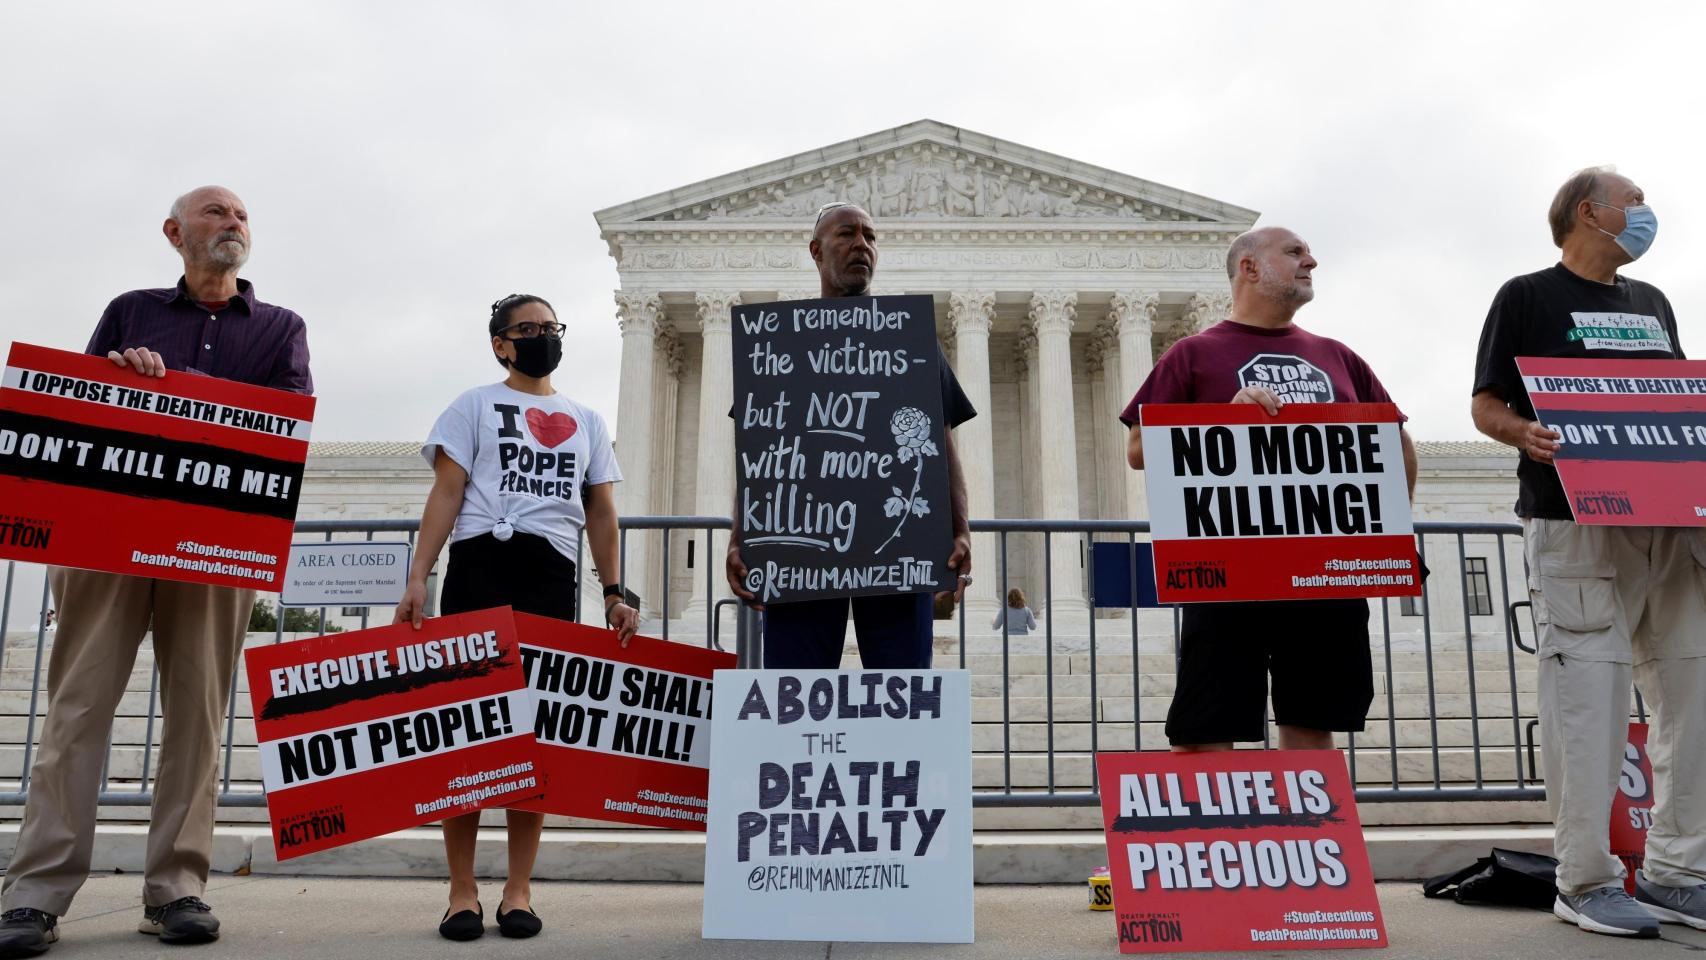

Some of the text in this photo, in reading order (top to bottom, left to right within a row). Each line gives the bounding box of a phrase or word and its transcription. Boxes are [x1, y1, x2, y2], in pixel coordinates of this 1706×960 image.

[877, 253, 939, 265] USTICE
[793, 298, 911, 332] remember
[1570, 328, 1622, 341] JOURNEY
[1627, 329, 1641, 339] OF
[749, 341, 794, 376] the
[1252, 363, 1312, 382] STOP
[1278, 391, 1317, 404] OW!
[1534, 377, 1543, 391] I
[1544, 377, 1603, 393] OPPOSE
[1604, 379, 1635, 393] THE
[1635, 379, 1686, 394] DEATH
[19, 370, 298, 437] I OPPOSE THE DEATH PENALTY
[743, 391, 880, 431] but NOT
[494, 403, 524, 440] I
[1547, 424, 1619, 445] DON'T
[1624, 425, 1679, 446] KILL
[0, 429, 292, 500] DON'T KILL FOR ME!
[499, 442, 576, 479] POPE
[742, 436, 893, 480] with more
[1170, 424, 1385, 477] NO MORE
[499, 470, 573, 500] FRANCIS
[743, 483, 857, 552] killing
[1183, 483, 1384, 538] KILLING!
[1575, 495, 1634, 516] ACTION
[131, 550, 275, 582] DeathPenaltyAction.org
[176, 541, 278, 566] #StopExecutions
[297, 553, 396, 568] AREA CLOSED
[1324, 558, 1412, 572] #StopExecutions
[293, 579, 300, 588] By
[318, 579, 325, 587] of
[335, 579, 357, 588] Supreme
[376, 578, 396, 586] Marshal
[1166, 566, 1227, 590] ACTION
[1292, 574, 1414, 588] DeathPenaltyAction.org
[270, 630, 500, 699] EXECUTE JUSTICE
[520, 647, 615, 701] THOU
[737, 673, 942, 725] ABOLISH
[278, 696, 513, 784] NOT PEOPLE!
[534, 699, 696, 762] NOT KILL!
[801, 732, 847, 756] THE
[448, 761, 534, 790] #StopExecutions
[759, 760, 920, 810] DEATH
[415, 775, 536, 816] DeathPenaltyAction.org
[1119, 769, 1331, 818] ALL LIFE IS
[279, 812, 346, 849] ACTION
[737, 809, 946, 862] PENALTY
[1126, 838, 1347, 890] PRECIOUS
[1119, 919, 1183, 943] ACTION
[1283, 909, 1375, 924] #StopExecutions
[1250, 927, 1379, 942] DeathPenaltyAction.org
